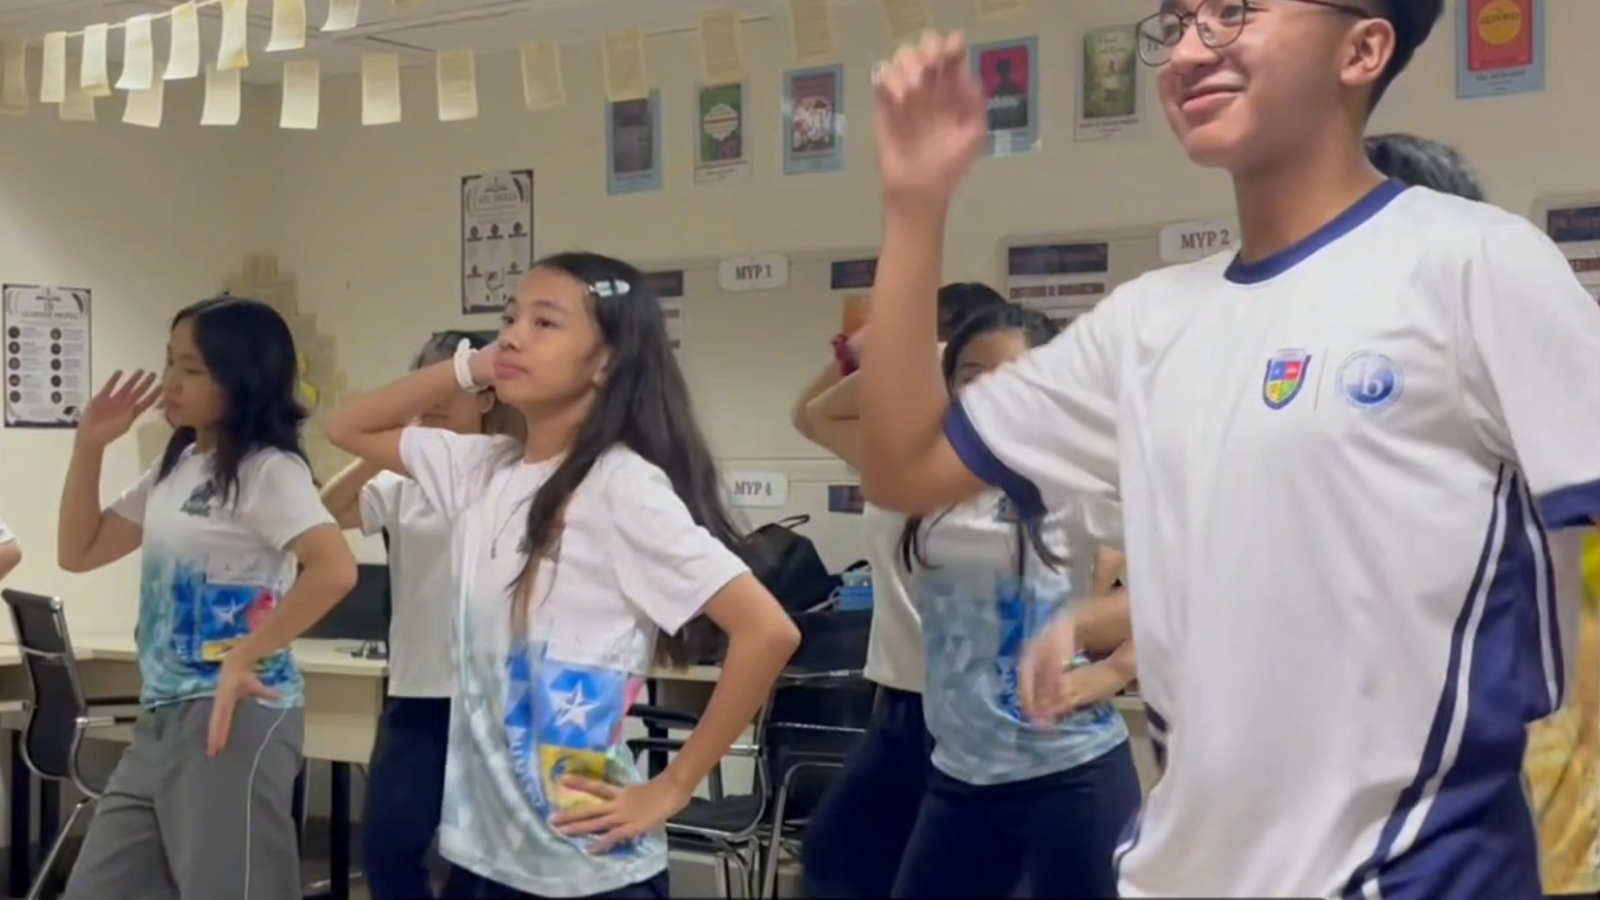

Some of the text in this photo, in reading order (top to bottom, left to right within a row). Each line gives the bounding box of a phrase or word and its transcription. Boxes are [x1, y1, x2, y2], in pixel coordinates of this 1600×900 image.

[1180, 229, 1230, 249] MYP 2
[735, 264, 772, 281] MYP 1
[734, 481, 762, 496] MYP
